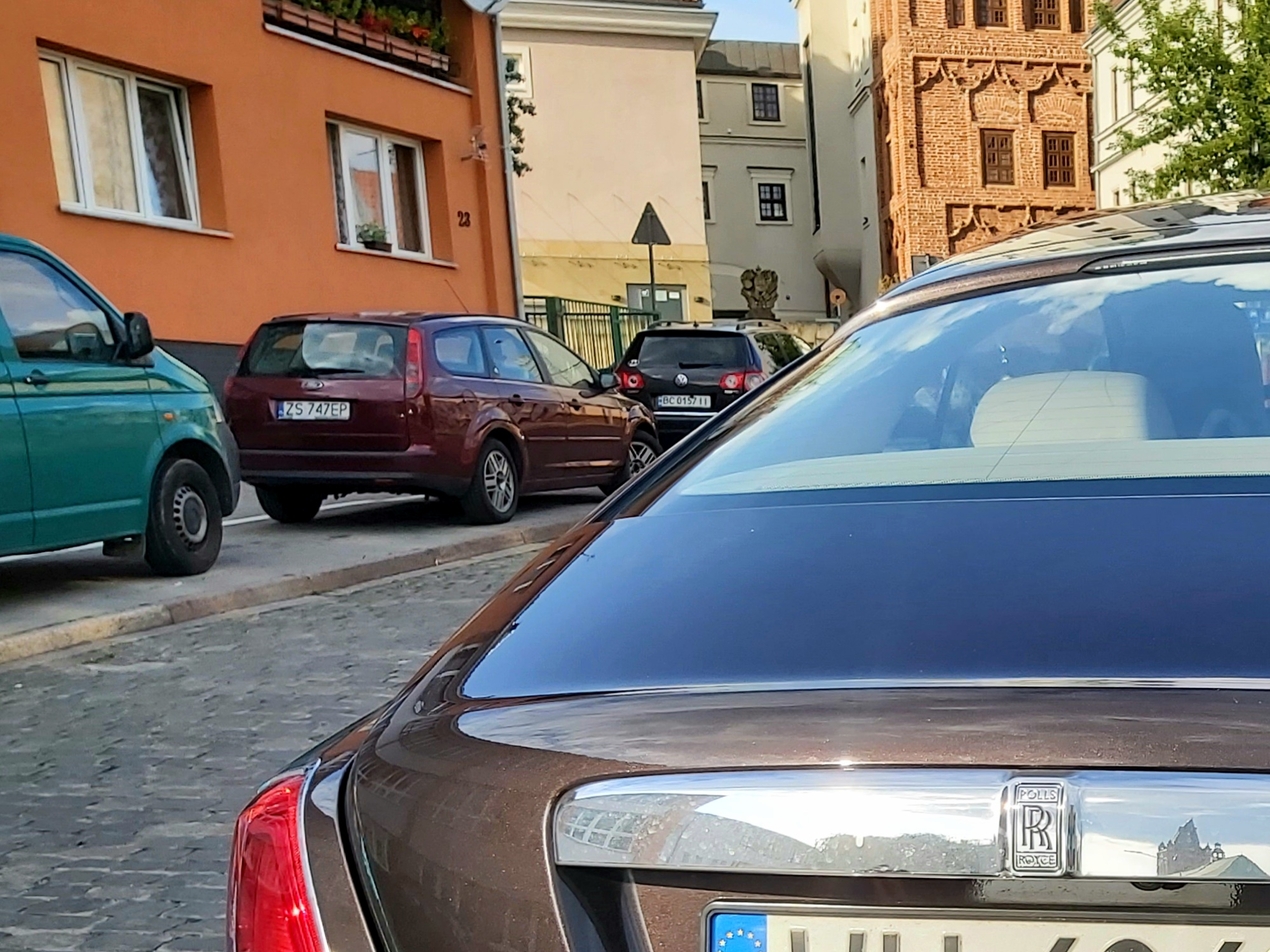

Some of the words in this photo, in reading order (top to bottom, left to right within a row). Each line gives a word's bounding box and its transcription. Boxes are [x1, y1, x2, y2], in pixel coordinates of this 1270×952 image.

[457, 210, 471, 228] 23
[286, 402, 303, 416] ZS
[308, 402, 348, 417] 747EP
[1018, 854, 1056, 866] ROYCE
